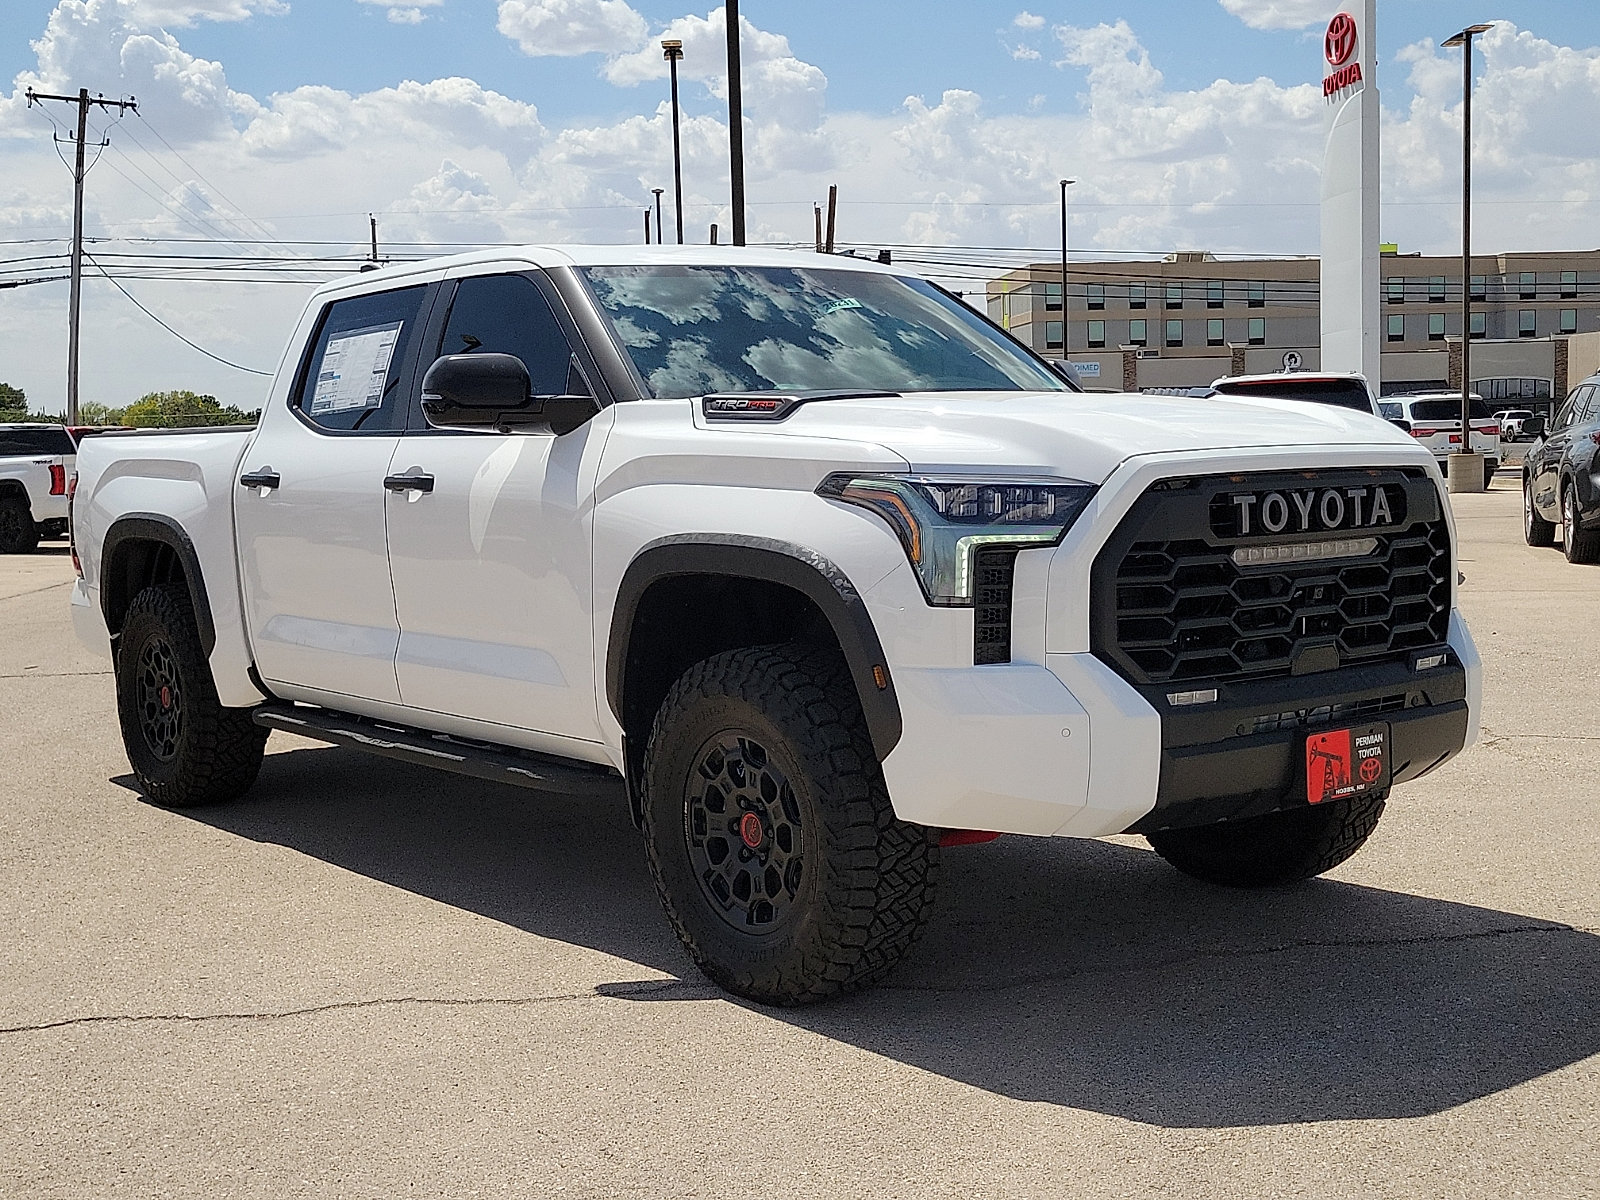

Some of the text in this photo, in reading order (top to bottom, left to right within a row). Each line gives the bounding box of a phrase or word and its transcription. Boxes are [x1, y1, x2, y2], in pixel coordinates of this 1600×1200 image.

[1322, 62, 1362, 97] TOYOTA
[715, 400, 776, 410] TRD PRO
[1233, 486, 1393, 535] TOYOTA
[1355, 733, 1384, 748] PERMIAN
[1357, 746, 1382, 760] TOYOTA
